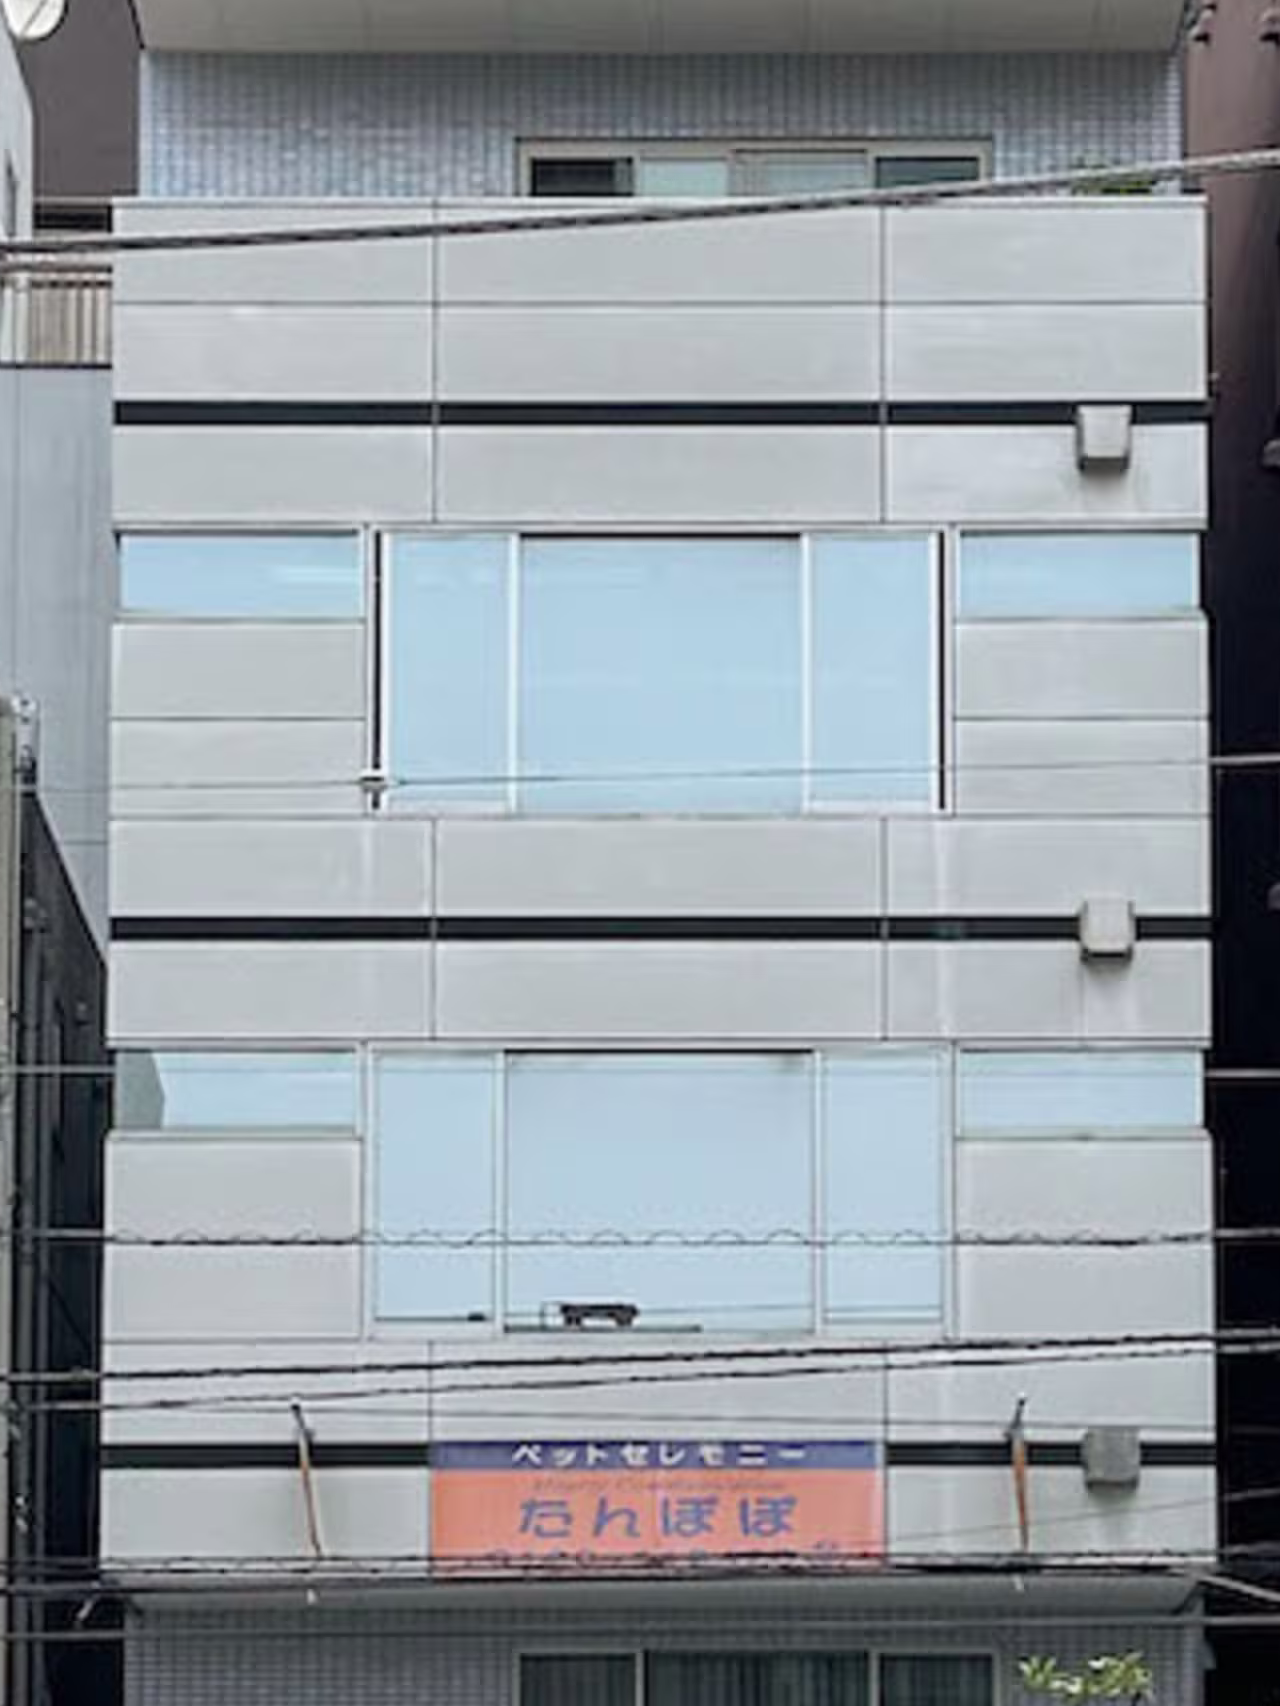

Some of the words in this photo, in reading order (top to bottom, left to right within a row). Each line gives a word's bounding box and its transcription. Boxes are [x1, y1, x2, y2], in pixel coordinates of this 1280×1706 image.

[512, 1444, 807, 1466] ペットセレモニー
[519, 1495, 797, 1539] たんぽぽ
